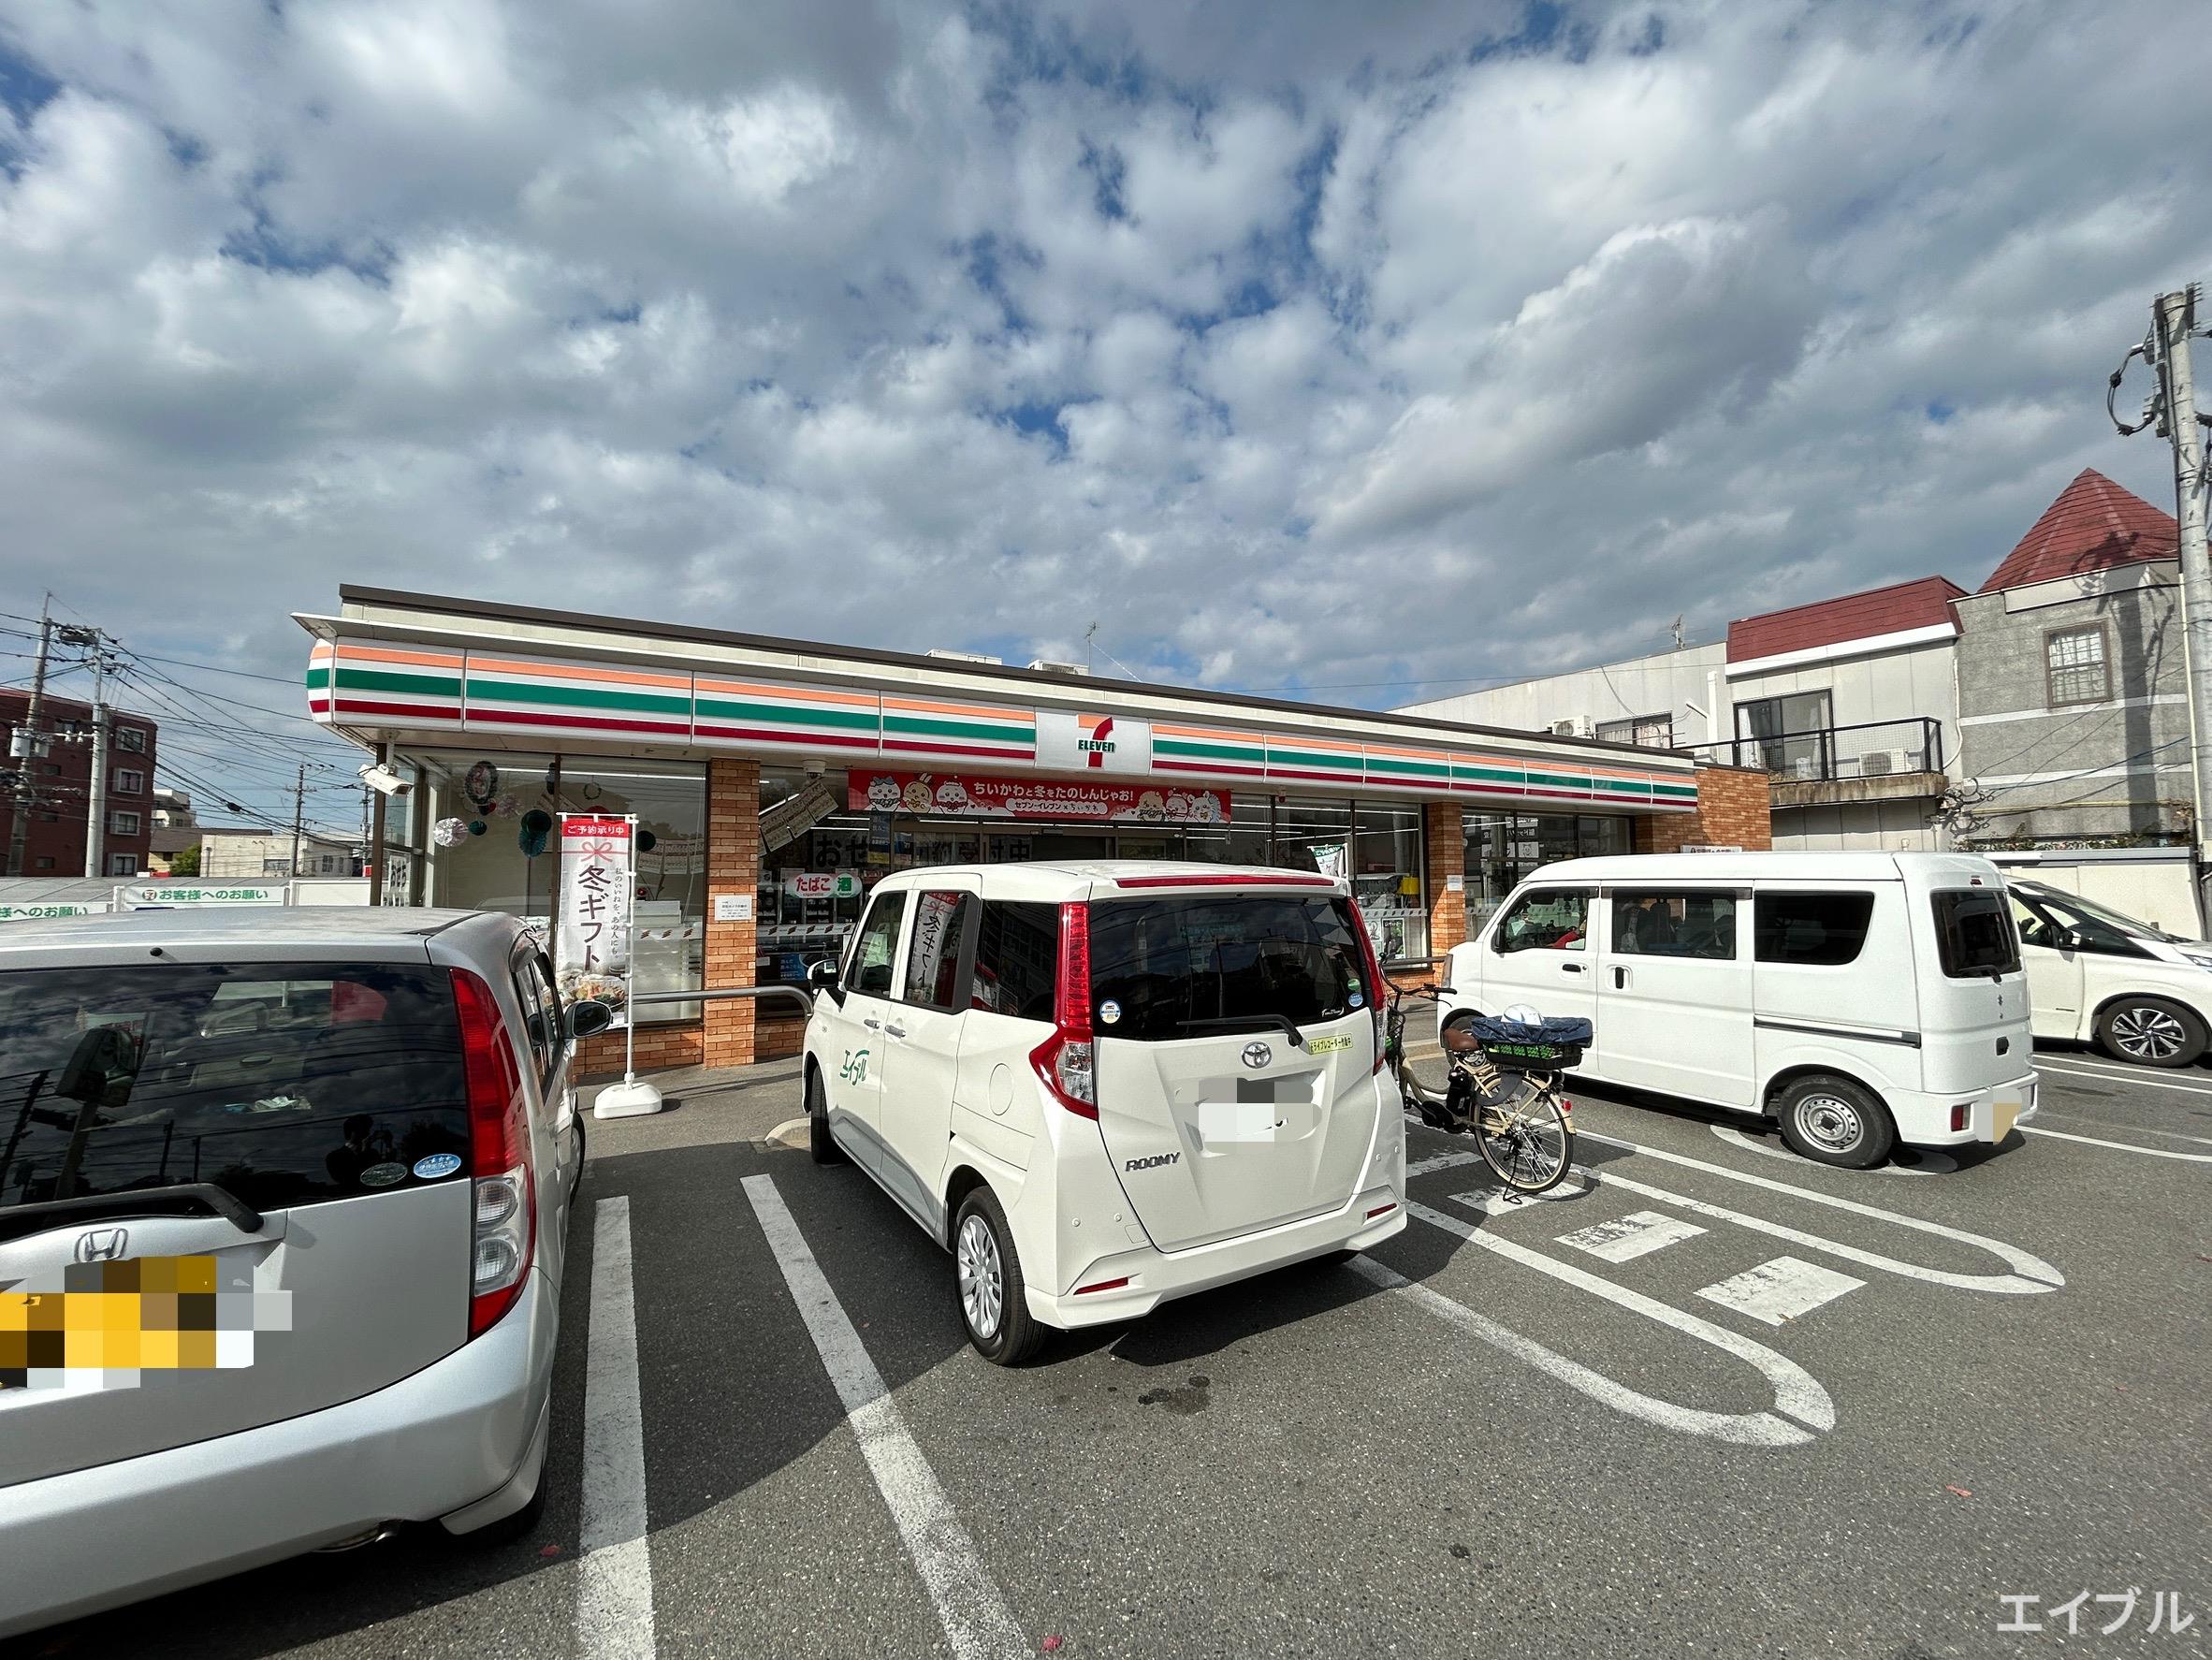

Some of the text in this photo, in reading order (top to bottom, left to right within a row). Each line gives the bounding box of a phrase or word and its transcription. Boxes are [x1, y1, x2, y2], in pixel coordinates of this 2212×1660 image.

[974, 782, 1133, 802] ちいかわと冬をたのしんじゃお!
[567, 825, 624, 836] ご予約承り中
[796, 877, 831, 892] たばこ
[837, 877, 852, 891] 酒
[159, 890, 268, 900] お客様へのお願い
[577, 866, 611, 970] 冬ギフト
[1126, 1152, 1180, 1172] ROOMY
